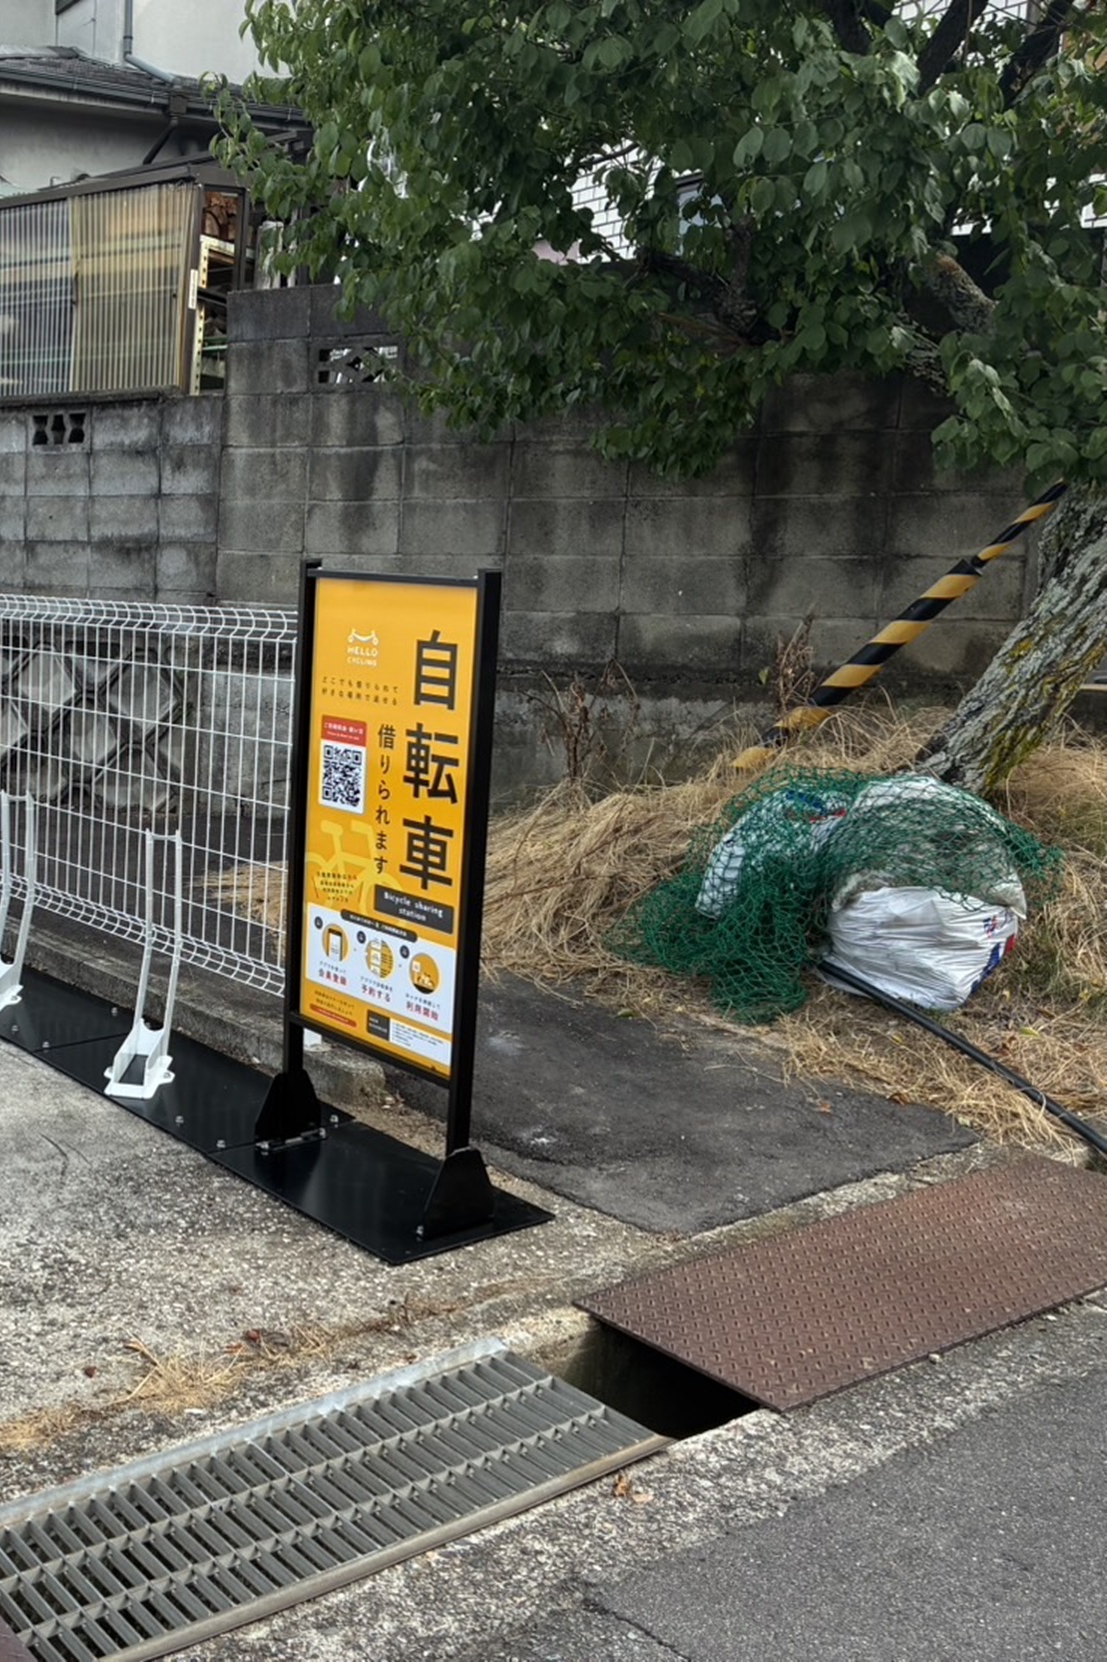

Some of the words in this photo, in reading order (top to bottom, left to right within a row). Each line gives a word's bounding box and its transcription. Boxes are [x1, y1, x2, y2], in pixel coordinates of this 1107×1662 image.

[347, 646, 378, 657] HELLO
[347, 656, 377, 667] CYCLING
[399, 630, 459, 890] 自転車
[374, 723, 397, 875] 借りられます
[383, 891, 411, 906] Bicycle
[414, 900, 443, 918] sharing
[398, 907, 427, 921] station
[318, 967, 348, 987] 会員登録
[361, 984, 391, 1003] 予約する
[405, 1001, 439, 1021] 利用開始
